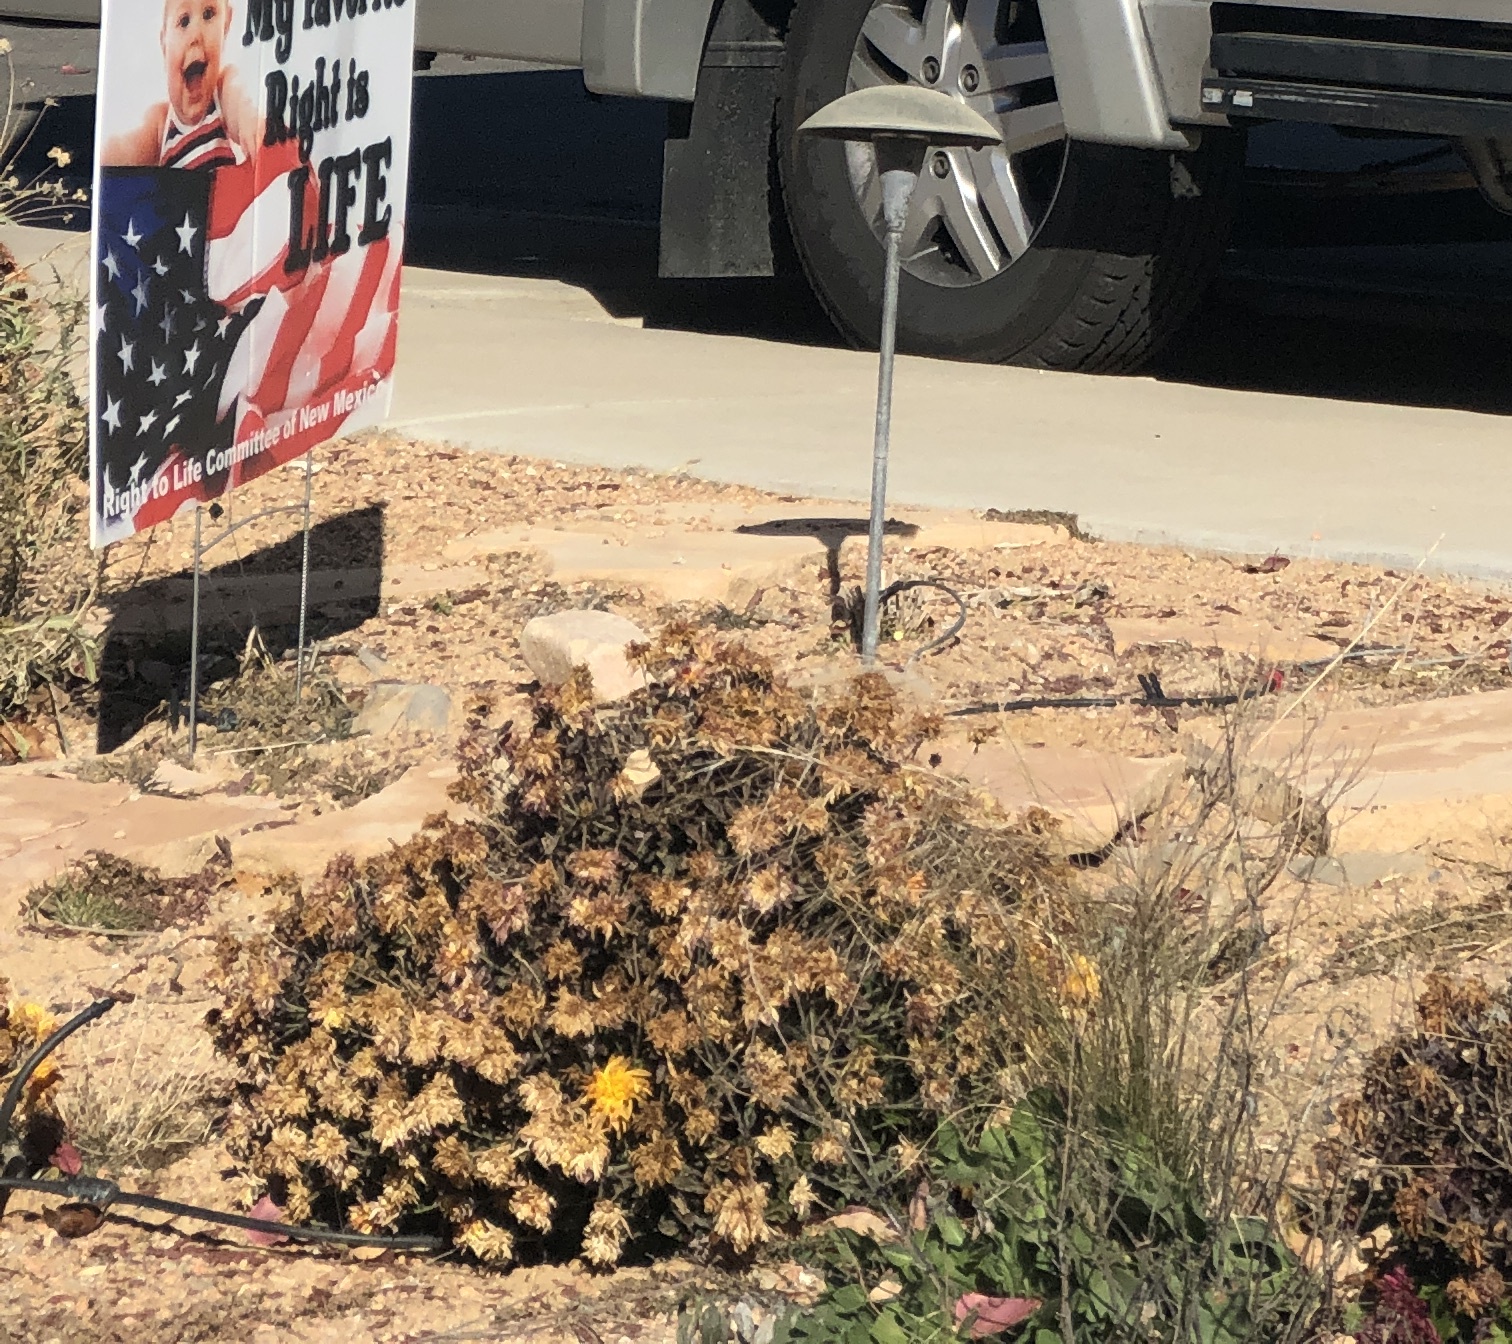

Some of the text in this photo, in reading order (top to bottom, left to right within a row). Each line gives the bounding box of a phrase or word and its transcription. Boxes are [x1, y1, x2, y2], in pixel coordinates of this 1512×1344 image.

[263, 56, 369, 163] Right is
[284, 136, 392, 275] LIFE
[103, 478, 148, 519] Right
[151, 473, 169, 499] to
[173, 457, 202, 491] Life
[205, 425, 280, 476] Committee
[283, 409, 298, 440] of
[299, 402, 330, 432] New
